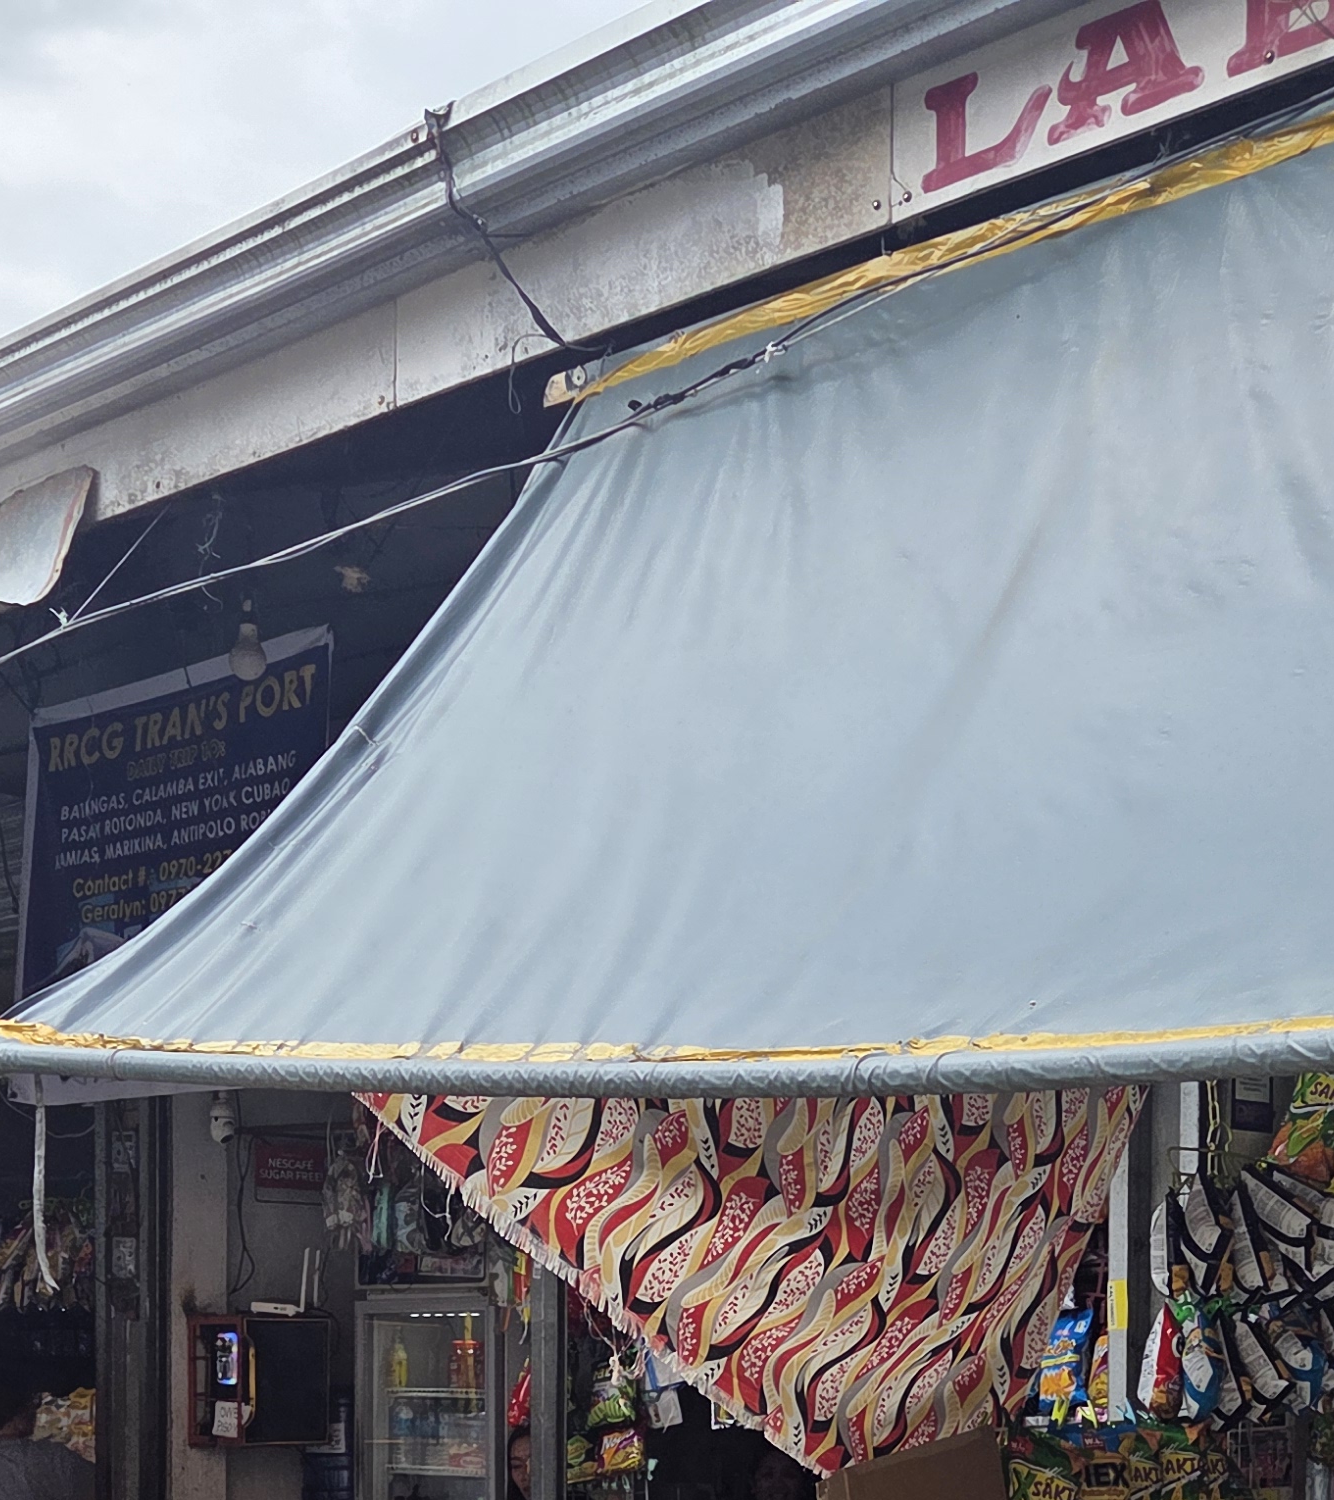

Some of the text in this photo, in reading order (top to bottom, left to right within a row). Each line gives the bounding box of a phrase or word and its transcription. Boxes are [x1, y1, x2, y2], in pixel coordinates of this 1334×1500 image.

[48, 663, 316, 772] RRCG TRAN'S PORT
[132, 776, 194, 806] CALAMBA
[232, 750, 296, 782] ALABANG
[104, 809, 167, 837] ROTONDA,
[171, 798, 199, 821] NEW
[241, 777, 290, 805] CUBAO
[171, 816, 235, 846] ANTIPOLO
[72, 868, 133, 898] Contact
[81, 899, 146, 924] Geralyn:
[259, 1168, 293, 1180] SUGAR
